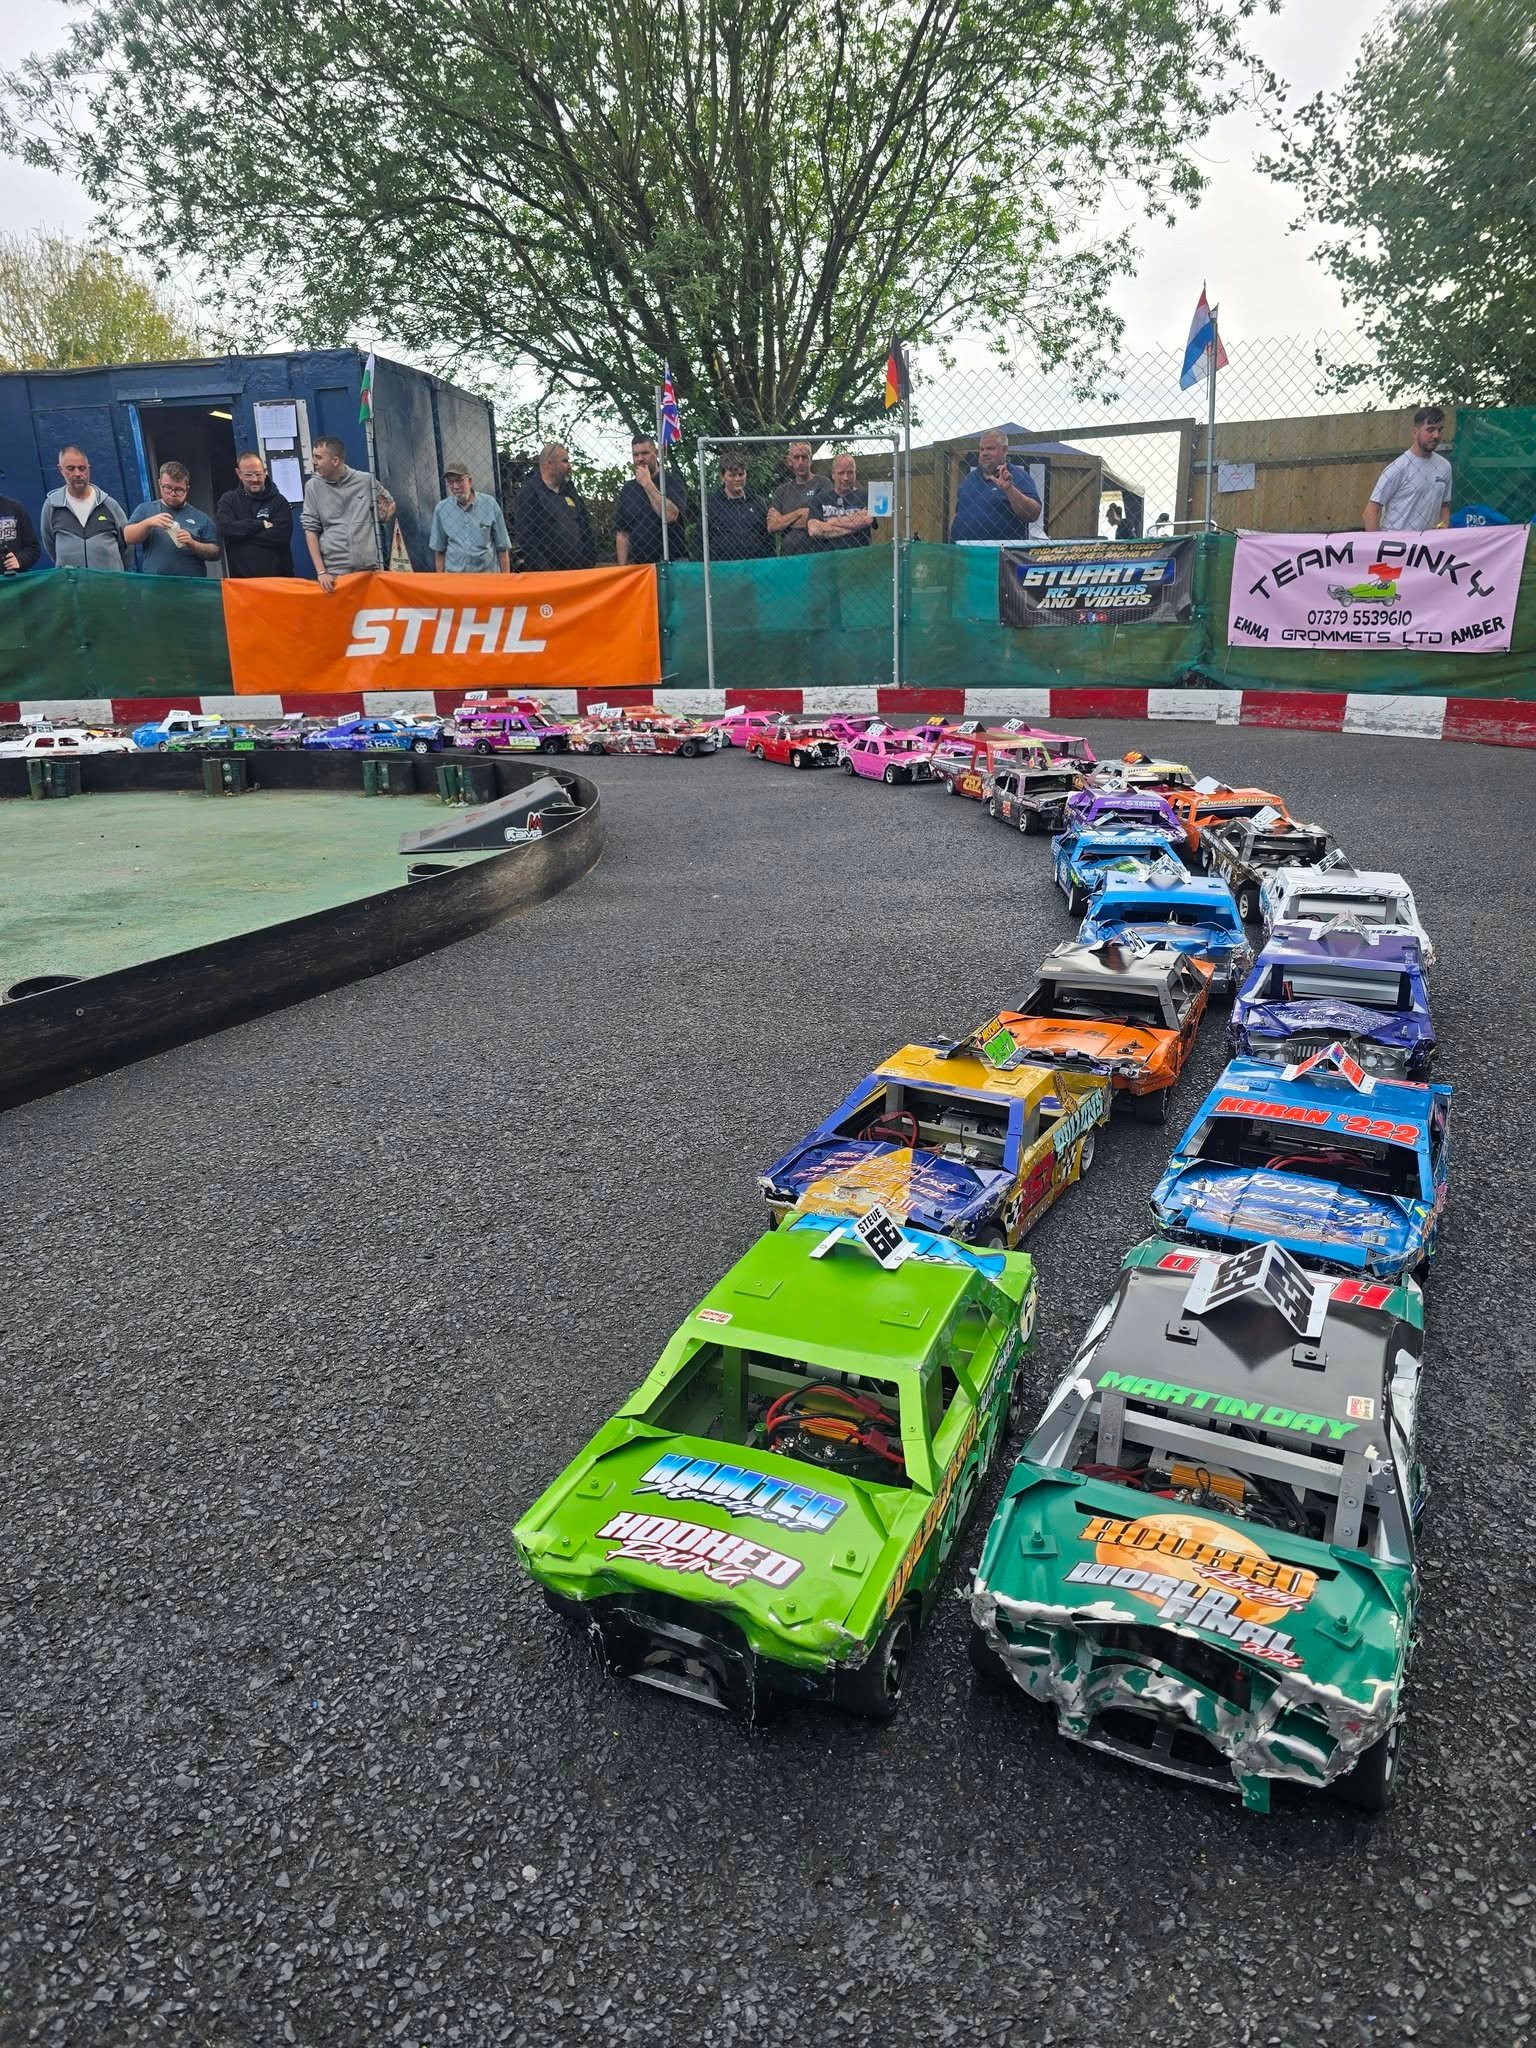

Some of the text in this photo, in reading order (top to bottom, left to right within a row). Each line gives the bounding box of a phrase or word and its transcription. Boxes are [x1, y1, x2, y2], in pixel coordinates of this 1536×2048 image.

[1028, 547, 1051, 556] FIND
[1051, 546, 1068, 554] ALL
[1069, 544, 1107, 553] PHOTOS
[1036, 554, 1062, 562] FROM
[1064, 552, 1104, 560] HOOKED
[1103, 551, 1140, 559] RACING
[1249, 540, 1495, 600] TEAM PINKY
[1036, 594, 1153, 609] AND VIDEOS
[1045, 584, 1148, 598] RC PHOTOS
[345, 606, 546, 657] STIHL
[1233, 616, 1270, 642] EMMA
[1307, 610, 1412, 626] 07379 5539610
[1451, 616, 1506, 646] AMBER
[1281, 628, 1443, 644] GROMMETS LTD
[1215, 1097, 1332, 1125] KEIRAN
[1233, 1174, 1371, 1207] HOOKED
[864, 1216, 903, 1261] 66
[1096, 1371, 1359, 1440] MARTIN DAY
[640, 1453, 848, 1534] KAMTEC
[595, 1511, 805, 1590] HOOKED
[1078, 1516, 1318, 1600] HOOKED
[1063, 1562, 1242, 1617] WORLD
[1192, 1563, 1305, 1612] Racing
[1157, 1594, 1297, 1656] FINAL
[1240, 1642, 1305, 1669] 2026
